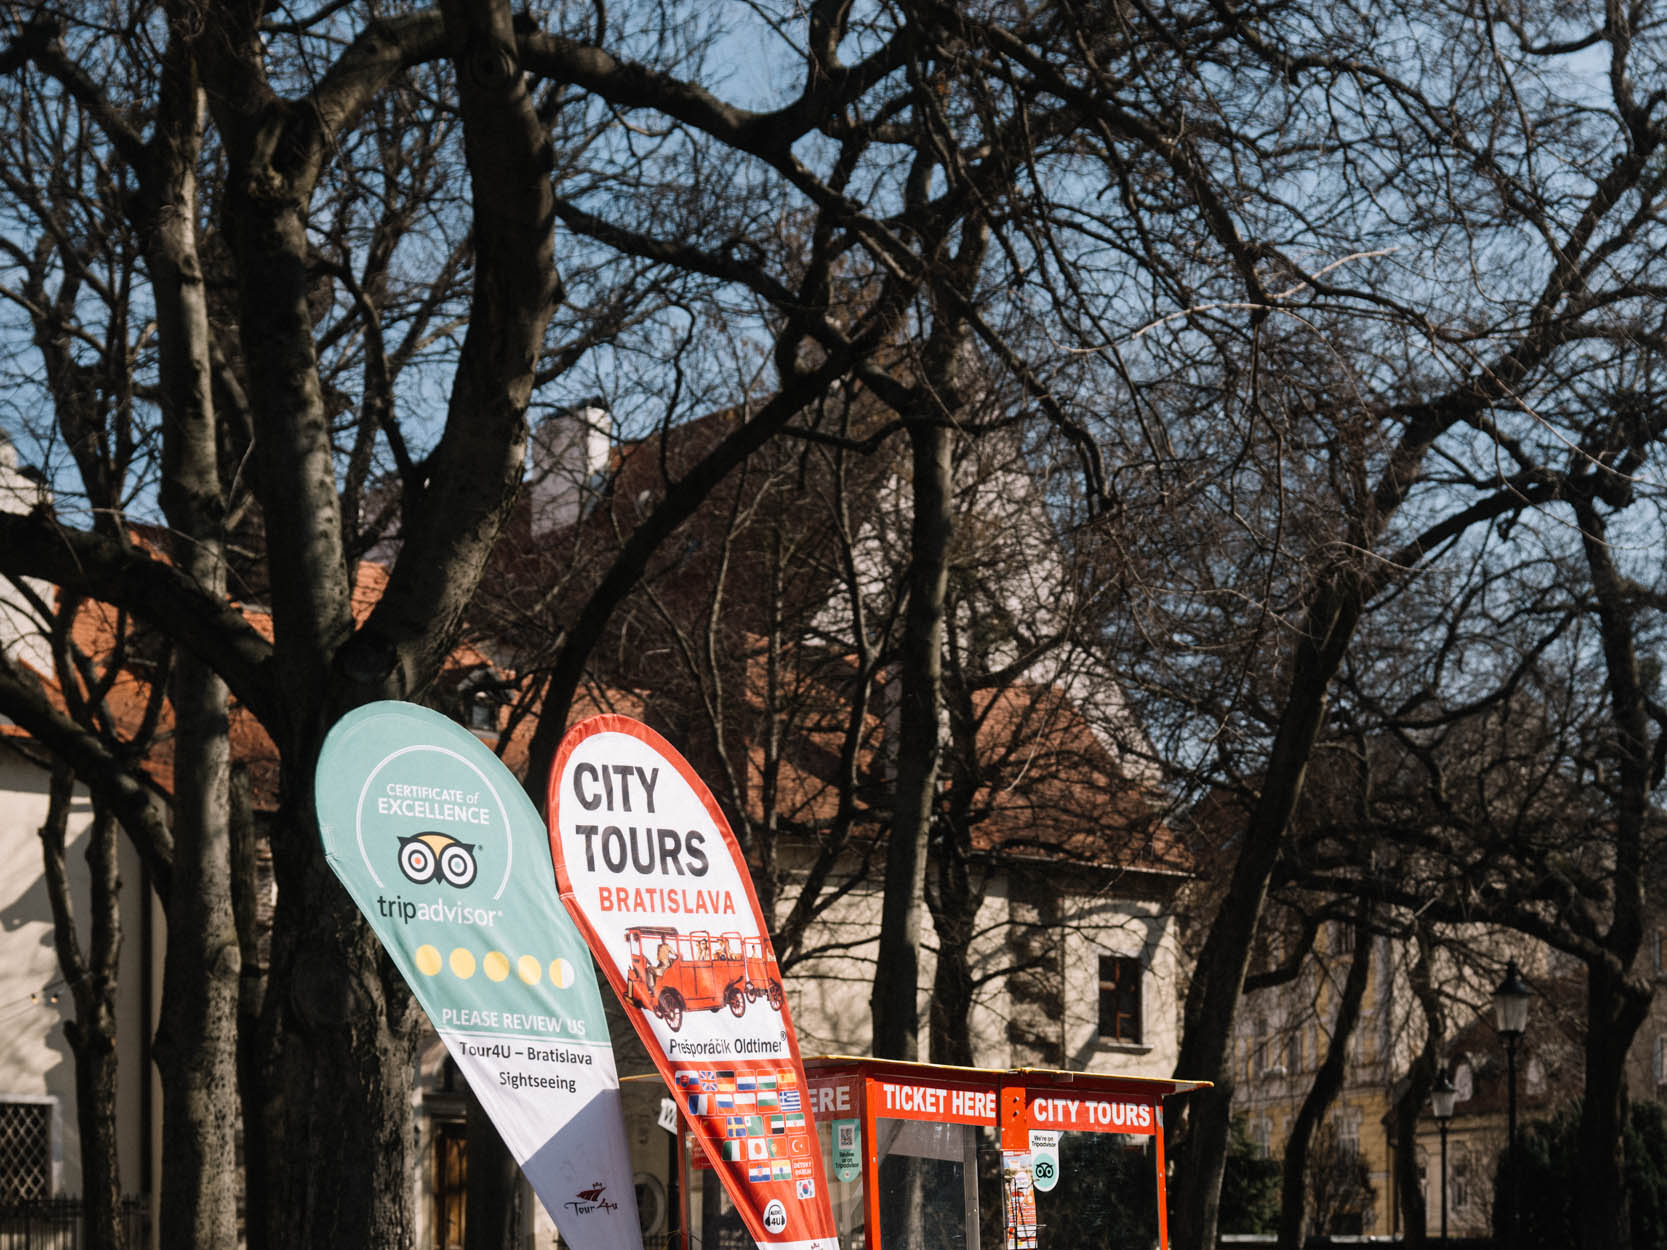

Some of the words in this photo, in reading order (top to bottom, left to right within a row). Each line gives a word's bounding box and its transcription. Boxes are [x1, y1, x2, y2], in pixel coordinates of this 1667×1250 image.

[386, 783, 463, 803] CERTIFICATE
[467, 792, 480, 804] of
[573, 762, 659, 813] CITY
[378, 798, 490, 825] EXCELLENCE
[576, 825, 709, 878] TOURS
[377, 895, 497, 926] tripadvisor
[598, 887, 735, 915] BRATISLAVA
[442, 1008, 499, 1027] PLEASE
[503, 1013, 562, 1032] REVIEW
[566, 1018, 586, 1035] US
[459, 1042, 511, 1058] Tour4U
[527, 1047, 592, 1065] Bratislava
[500, 1071, 577, 1093] Sightseeing
[810, 1086, 851, 1113] ERE
[883, 1084, 948, 1113] TICKET
[952, 1090, 997, 1118] HERE
[1034, 1098, 1080, 1122] CITY
[1085, 1101, 1151, 1127] TOURS
